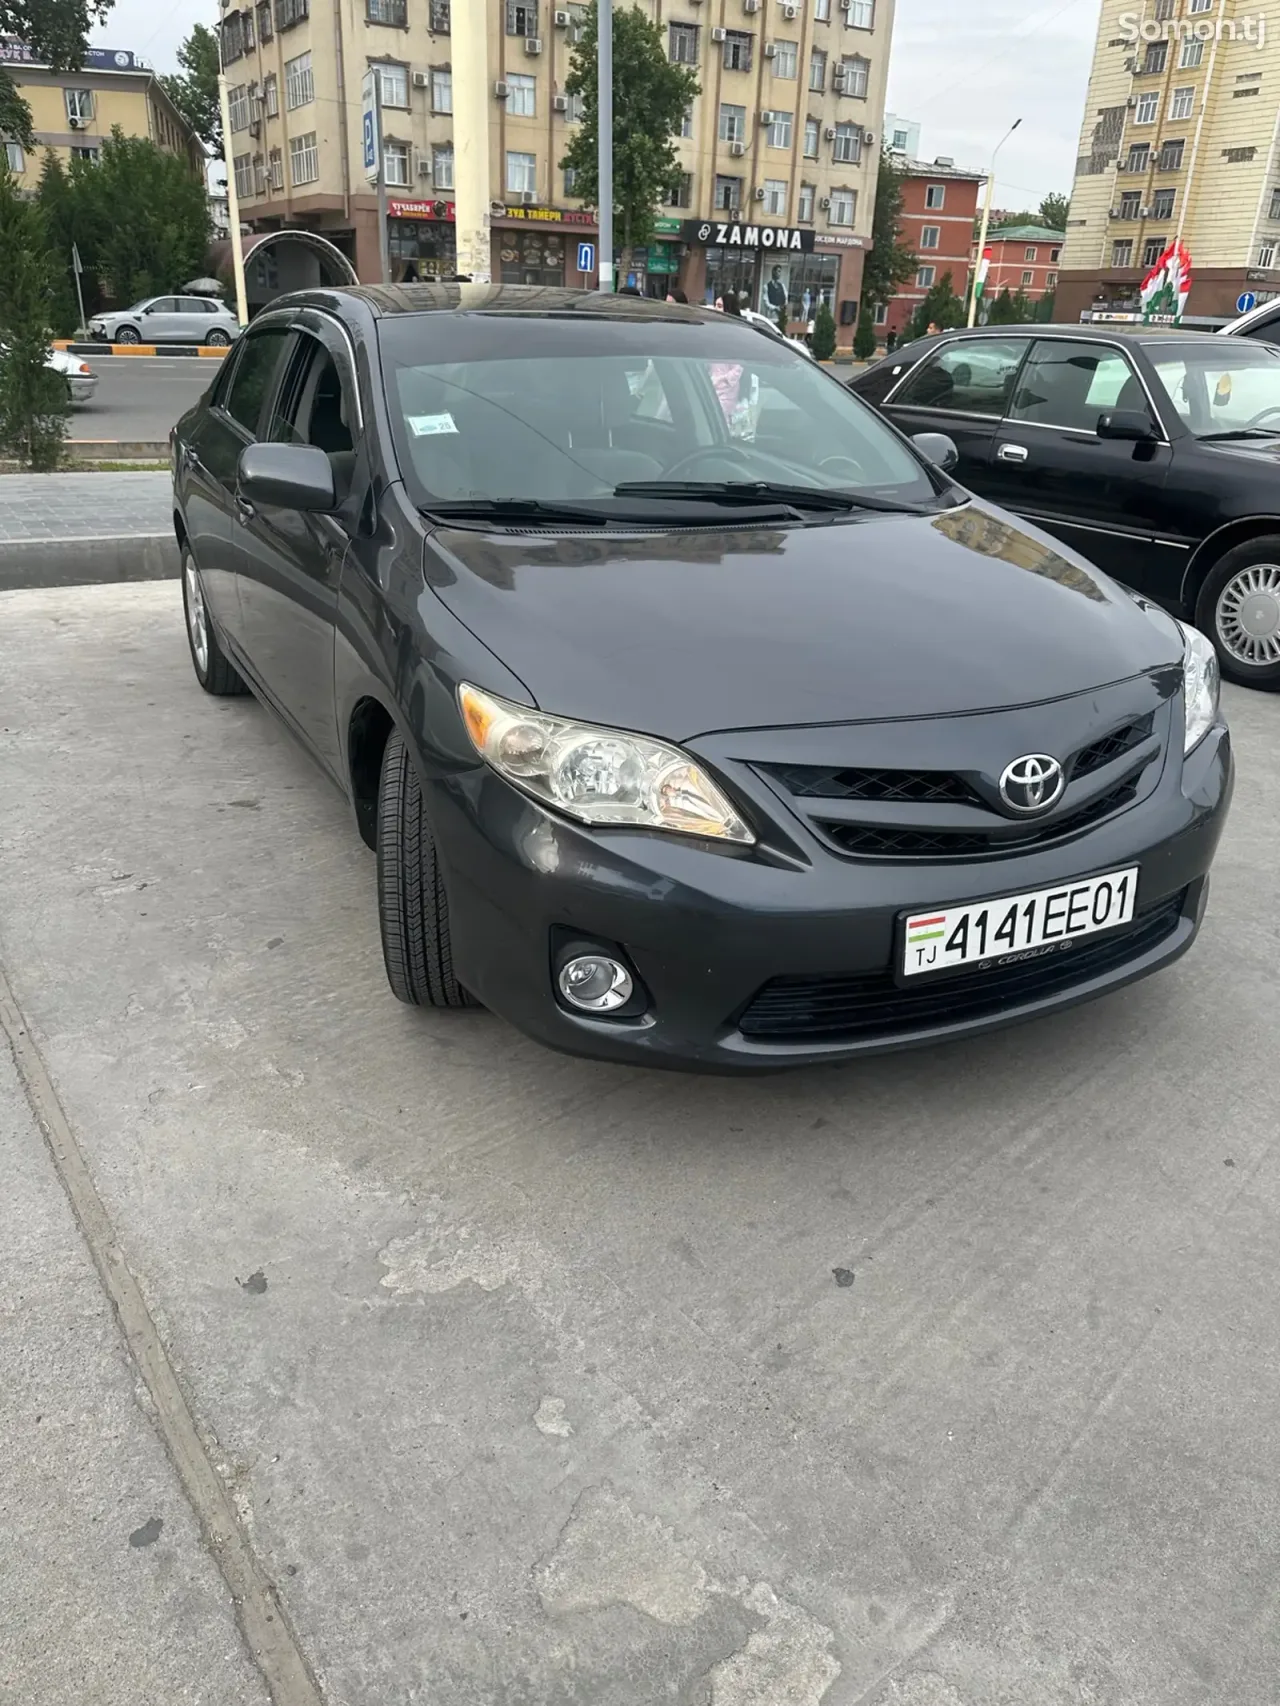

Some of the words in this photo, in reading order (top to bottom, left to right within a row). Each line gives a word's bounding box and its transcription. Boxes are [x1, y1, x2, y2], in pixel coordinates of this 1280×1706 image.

[507, 207, 525, 219] ЗУД
[716, 224, 802, 249] ZAMONA
[945, 876, 1129, 959] 4141EE01
[916, 945, 937, 966] TJ
[998, 945, 1055, 965] COROLLA
